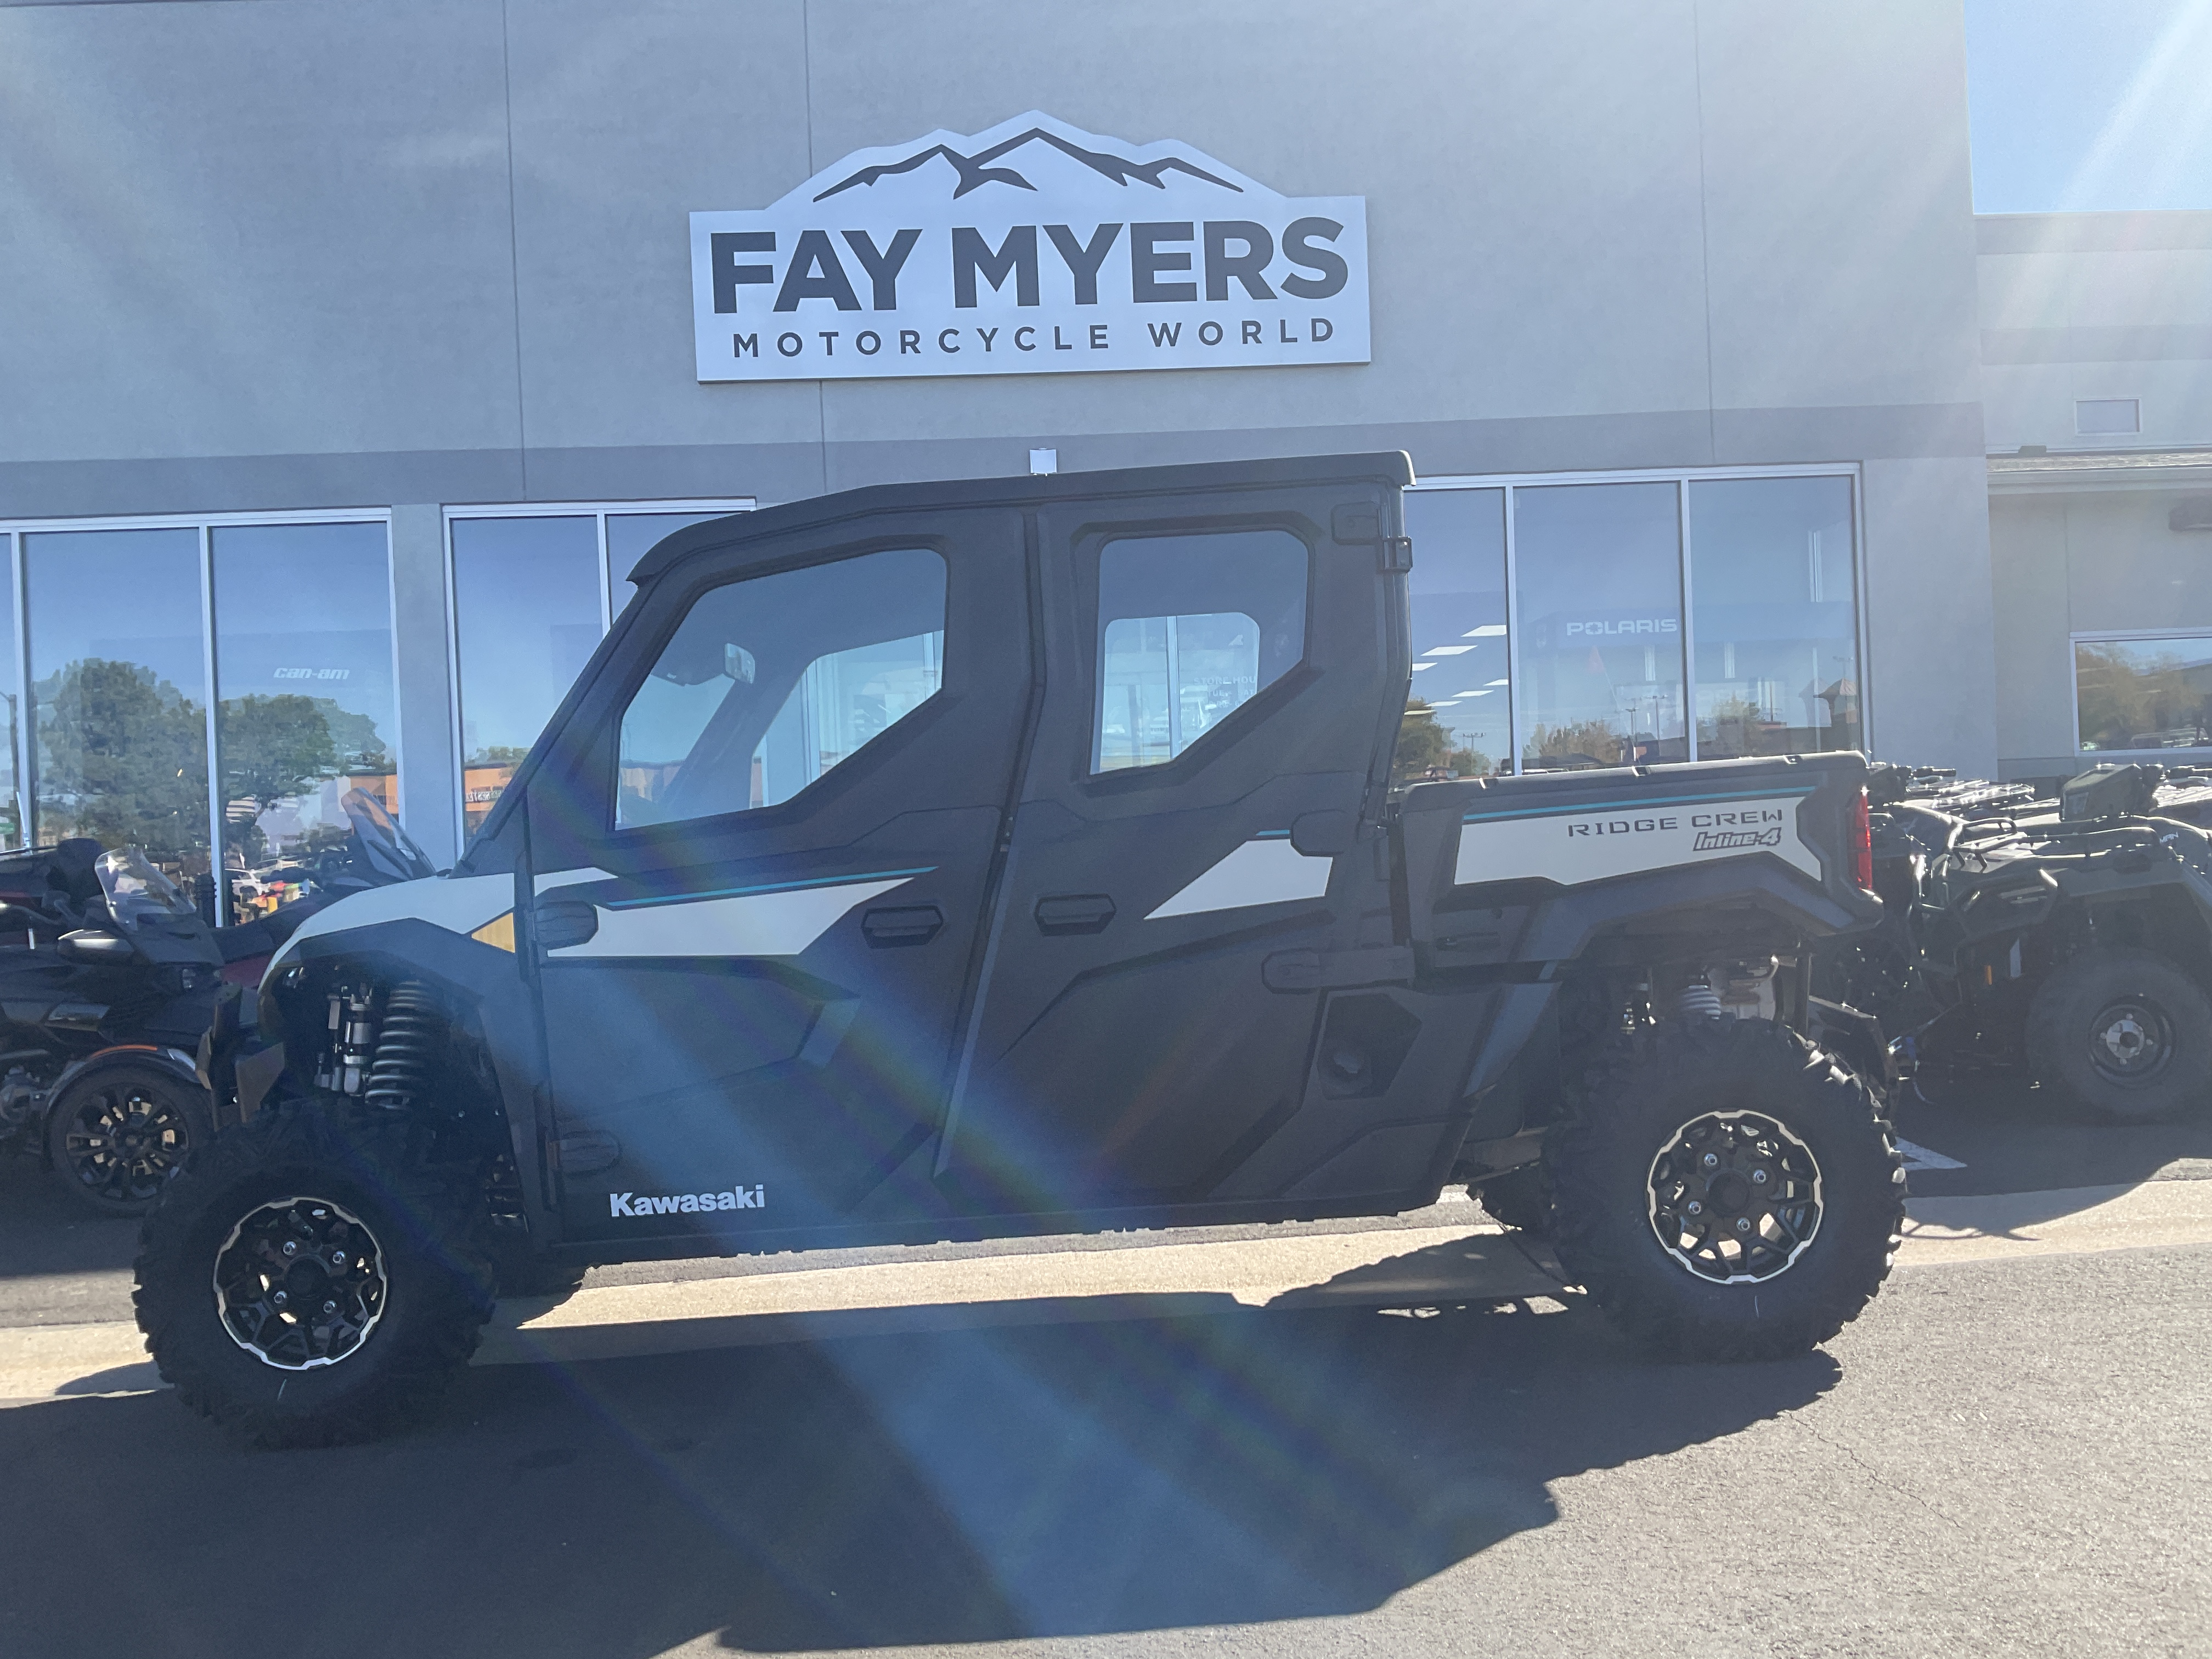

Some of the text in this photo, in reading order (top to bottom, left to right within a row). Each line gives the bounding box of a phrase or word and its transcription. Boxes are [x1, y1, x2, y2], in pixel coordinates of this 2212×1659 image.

[710, 217, 1348, 314] FAY MYERS
[733, 318, 1333, 357] MOTORCYCLE WORLD
[1567, 619, 1677, 636] POLARIS
[274, 668, 350, 680] can-am
[1194, 676, 1231, 685] STORE
[1568, 810, 1782, 837] RIDGE CREW
[1693, 827, 1782, 851] Inline-4
[610, 1184, 765, 1217] Kawasaki
